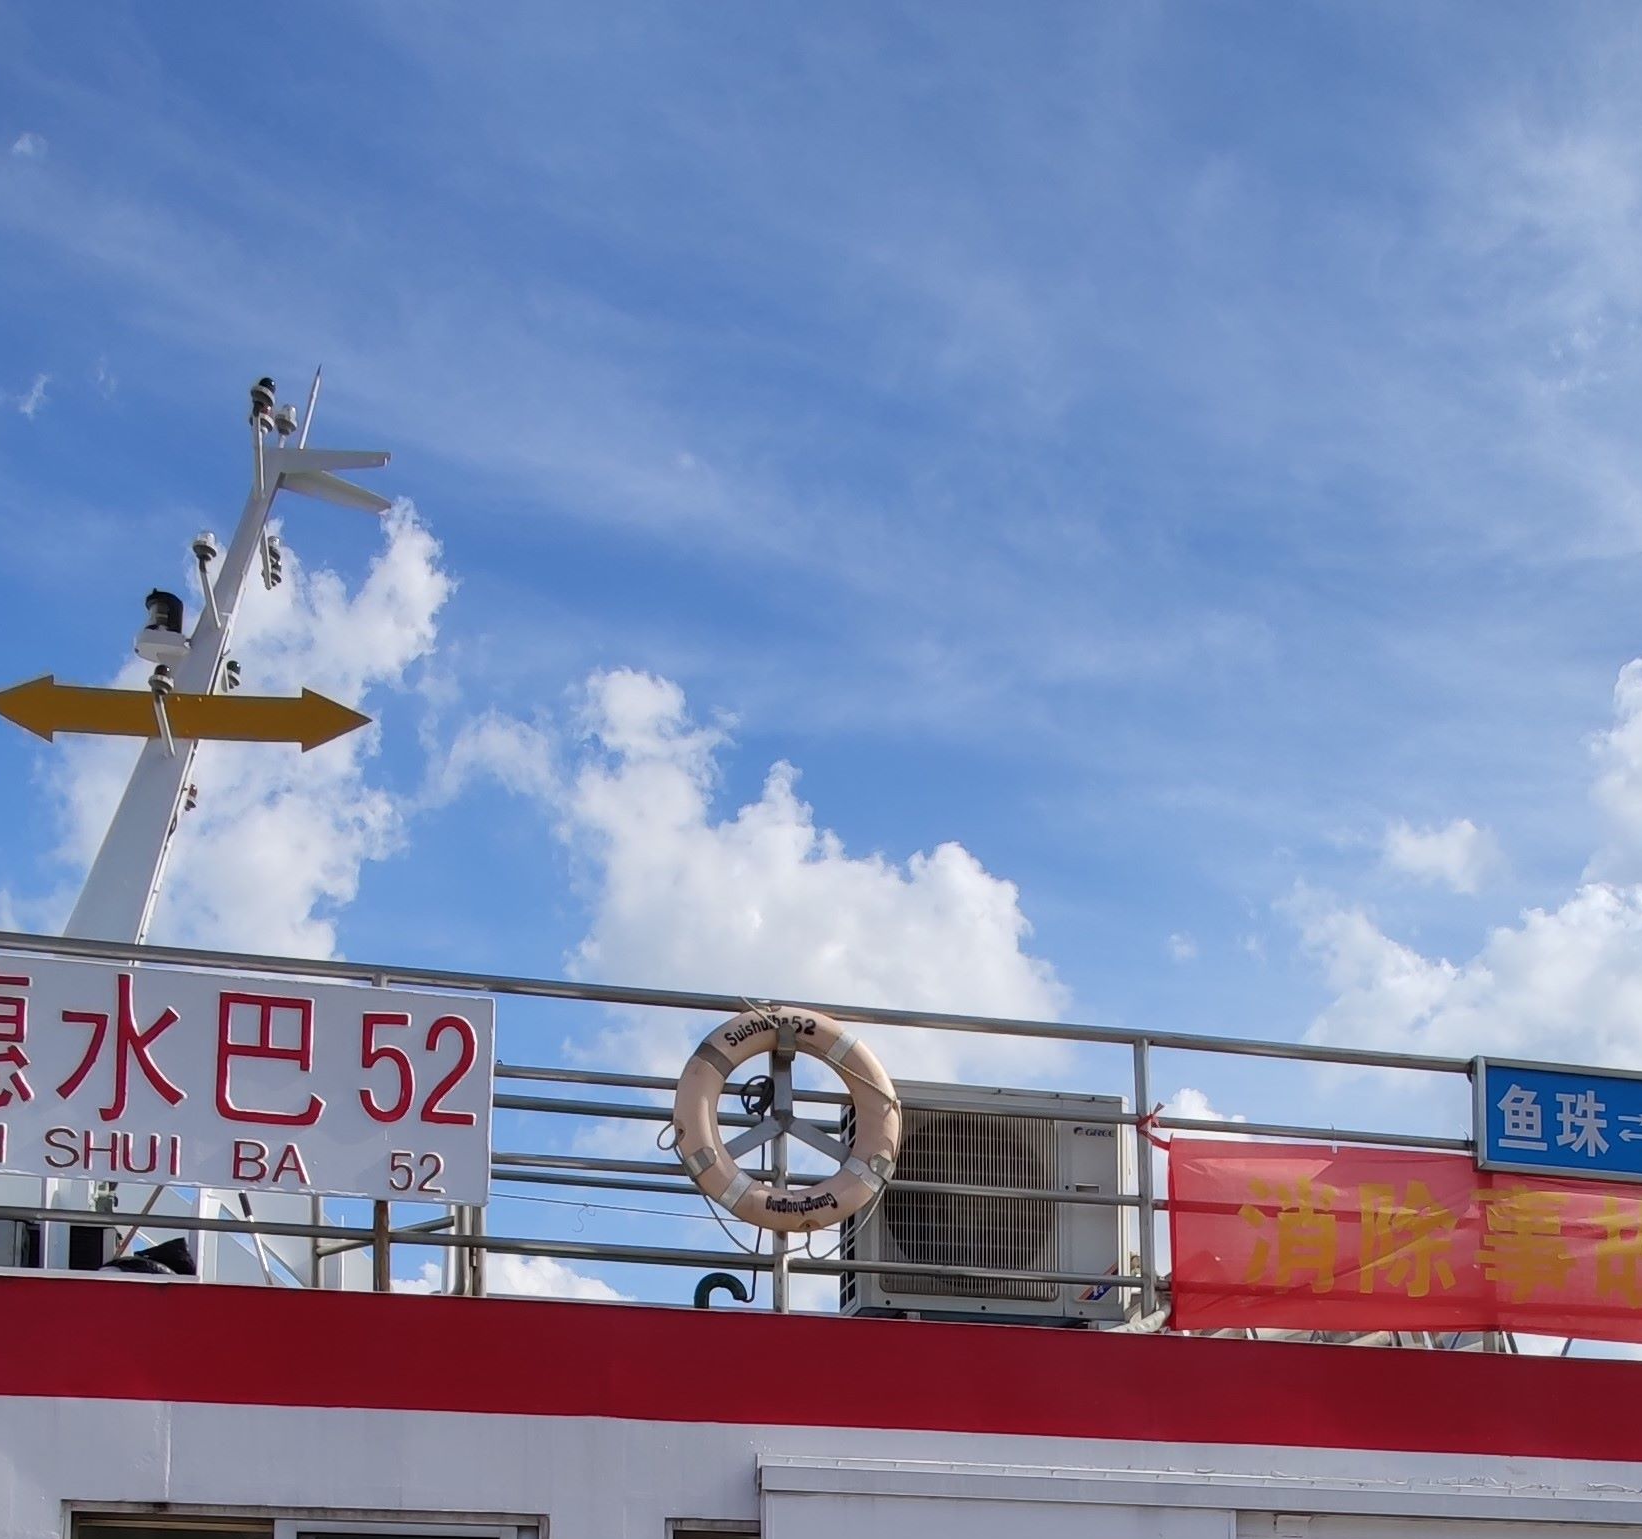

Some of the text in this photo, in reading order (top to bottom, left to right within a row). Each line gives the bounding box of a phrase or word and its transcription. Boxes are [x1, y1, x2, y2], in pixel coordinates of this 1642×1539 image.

[1497, 1083, 1609, 1158] 鱼珠
[44, 1126, 181, 1176] SHUI
[232, 1139, 311, 1184] BA
[389, 1150, 446, 1194] 52
